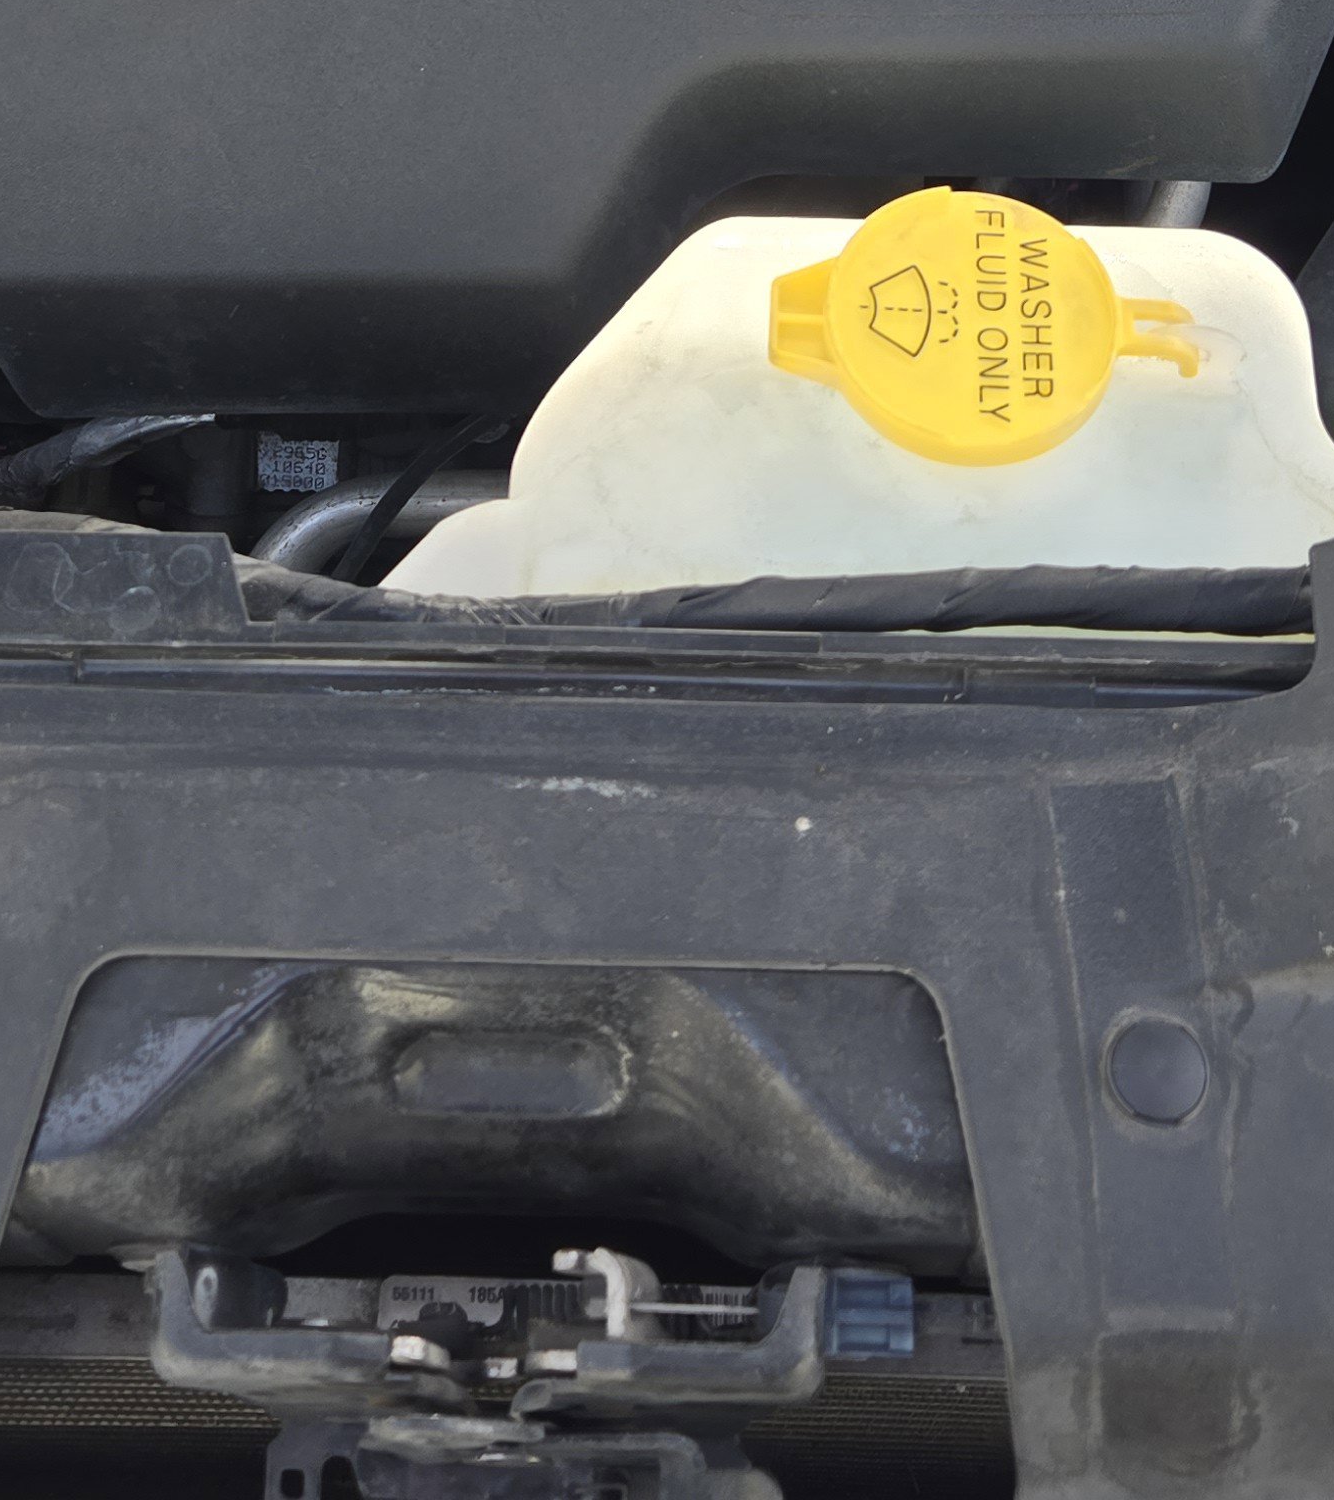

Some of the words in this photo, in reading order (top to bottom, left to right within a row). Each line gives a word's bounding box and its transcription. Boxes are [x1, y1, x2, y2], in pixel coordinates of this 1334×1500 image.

[975, 209, 1008, 312] FLUID
[1019, 238, 1055, 398] WASHER
[977, 327, 1011, 424] ONLY
